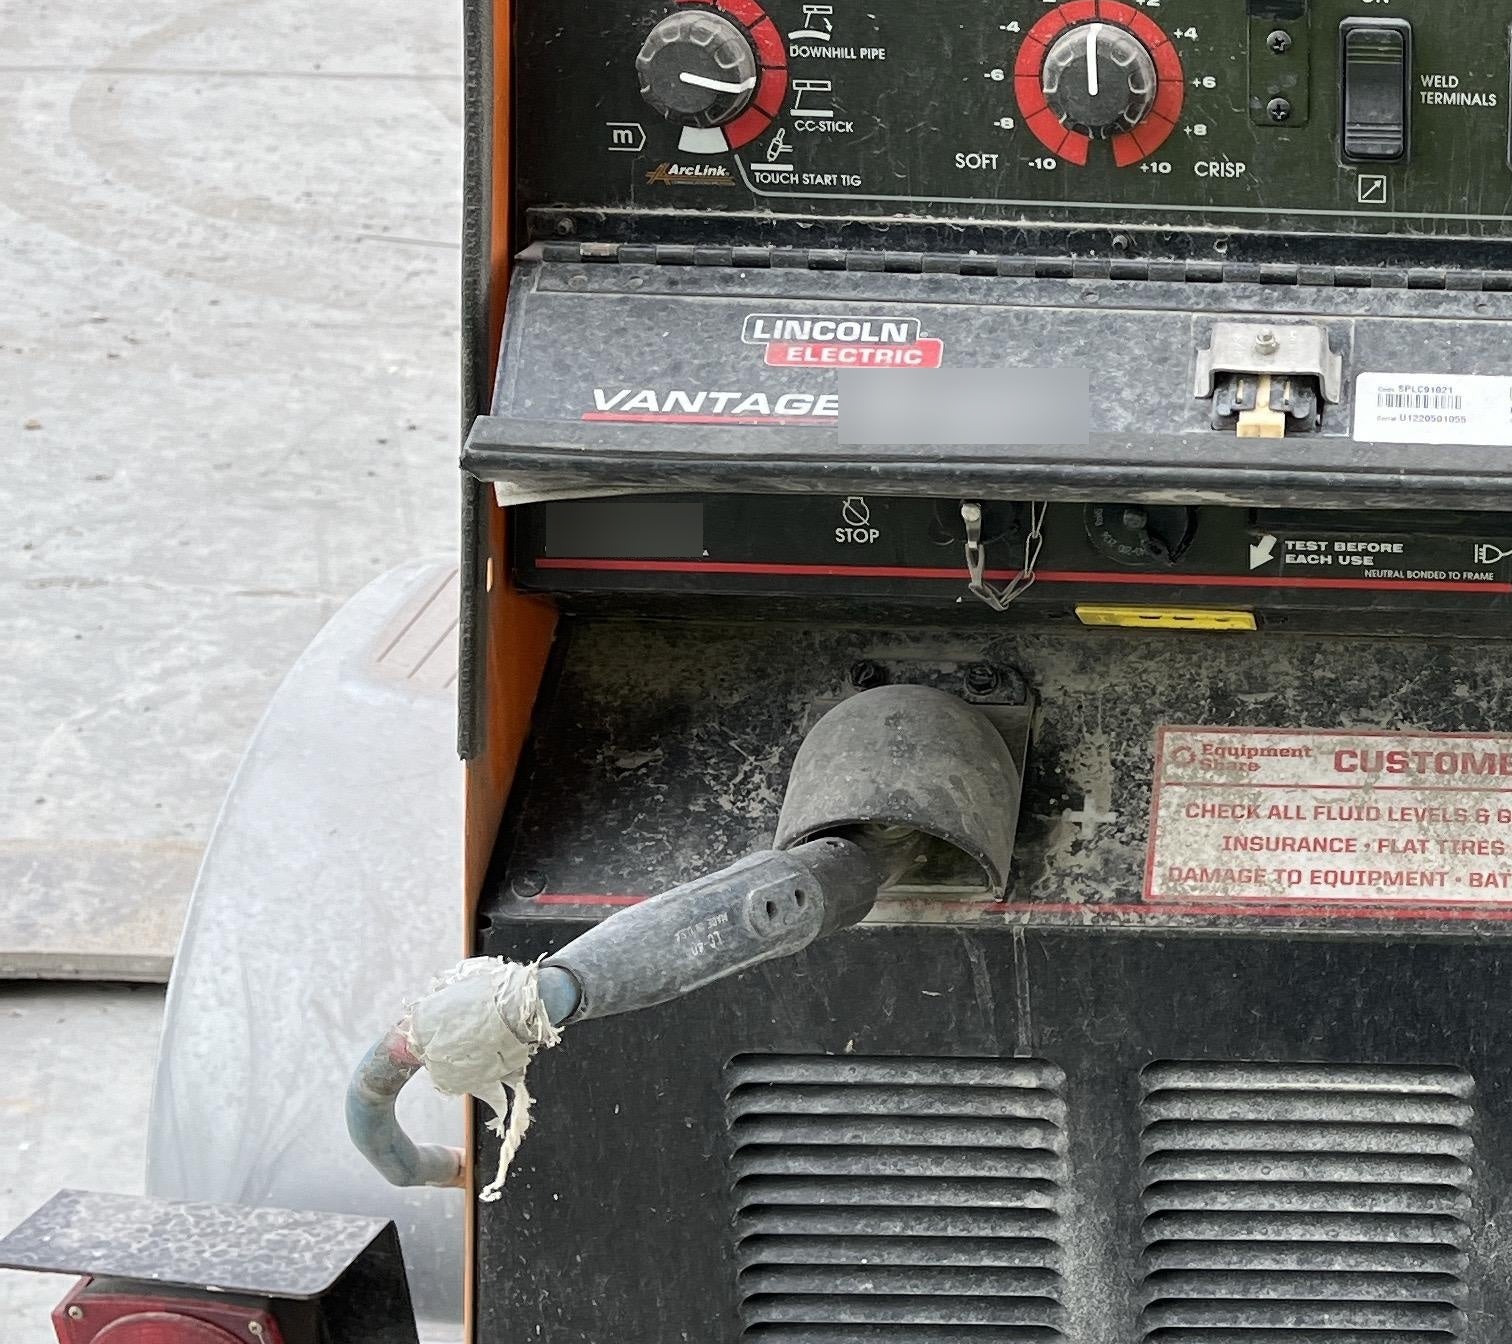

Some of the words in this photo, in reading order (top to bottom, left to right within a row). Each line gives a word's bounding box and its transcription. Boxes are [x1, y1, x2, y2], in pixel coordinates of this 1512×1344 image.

[999, 21, 1020, 32] -4
[1174, 27, 1198, 41] +4
[790, 46, 857, 60] DOWNHILL
[860, 48, 886, 60] PIPE
[984, 69, 1005, 81] -6
[1192, 76, 1217, 88] +6
[1420, 75, 1459, 89] WELD
[1420, 91, 1497, 107] TERMINALS
[794, 120, 854, 133] CC-STICK
[993, 118, 1014, 129] -8
[1184, 124, 1208, 136] +8
[955, 153, 999, 169] SOFT
[1028, 158, 1056, 169] -10
[1140, 162, 1172, 174] +10
[1194, 162, 1246, 177] CRISP
[754, 172, 799, 185] TOUCH
[802, 173, 838, 186] START
[841, 174, 861, 186] TIG
[753, 319, 909, 343] LINCOLN
[786, 346, 923, 365] ELECTRIC
[593, 389, 839, 416] VANTAGE
[835, 527, 880, 543] STOP
[1285, 540, 1328, 551] TEST
[1334, 542, 1404, 553] BEFORE
[1285, 554, 1332, 565] EACH
[1339, 555, 1374, 566] USE
[1364, 569, 1404, 578] NEUTRAL
[1407, 570, 1447, 579] BONDED
[1449, 571, 1460, 580] TO
[1463, 571, 1494, 581] FRAME
[1201, 743, 1312, 759] Equipment
[1200, 759, 1261, 772] Share
[1185, 803, 1260, 821] CHECK
[1267, 805, 1302, 821] ALL
[1313, 805, 1381, 822] FLUID
[1388, 806, 1468, 824] LEVELS
[1475, 808, 1490, 824] &
[1222, 835, 1357, 853] INSURANCE
[1377, 838, 1428, 854] FLAT
[1438, 839, 1505, 856] TIRES
[1168, 867, 1266, 886] DAMAGE
[1274, 869, 1301, 886] TO
[1310, 870, 1449, 888] EQUIPMENT
